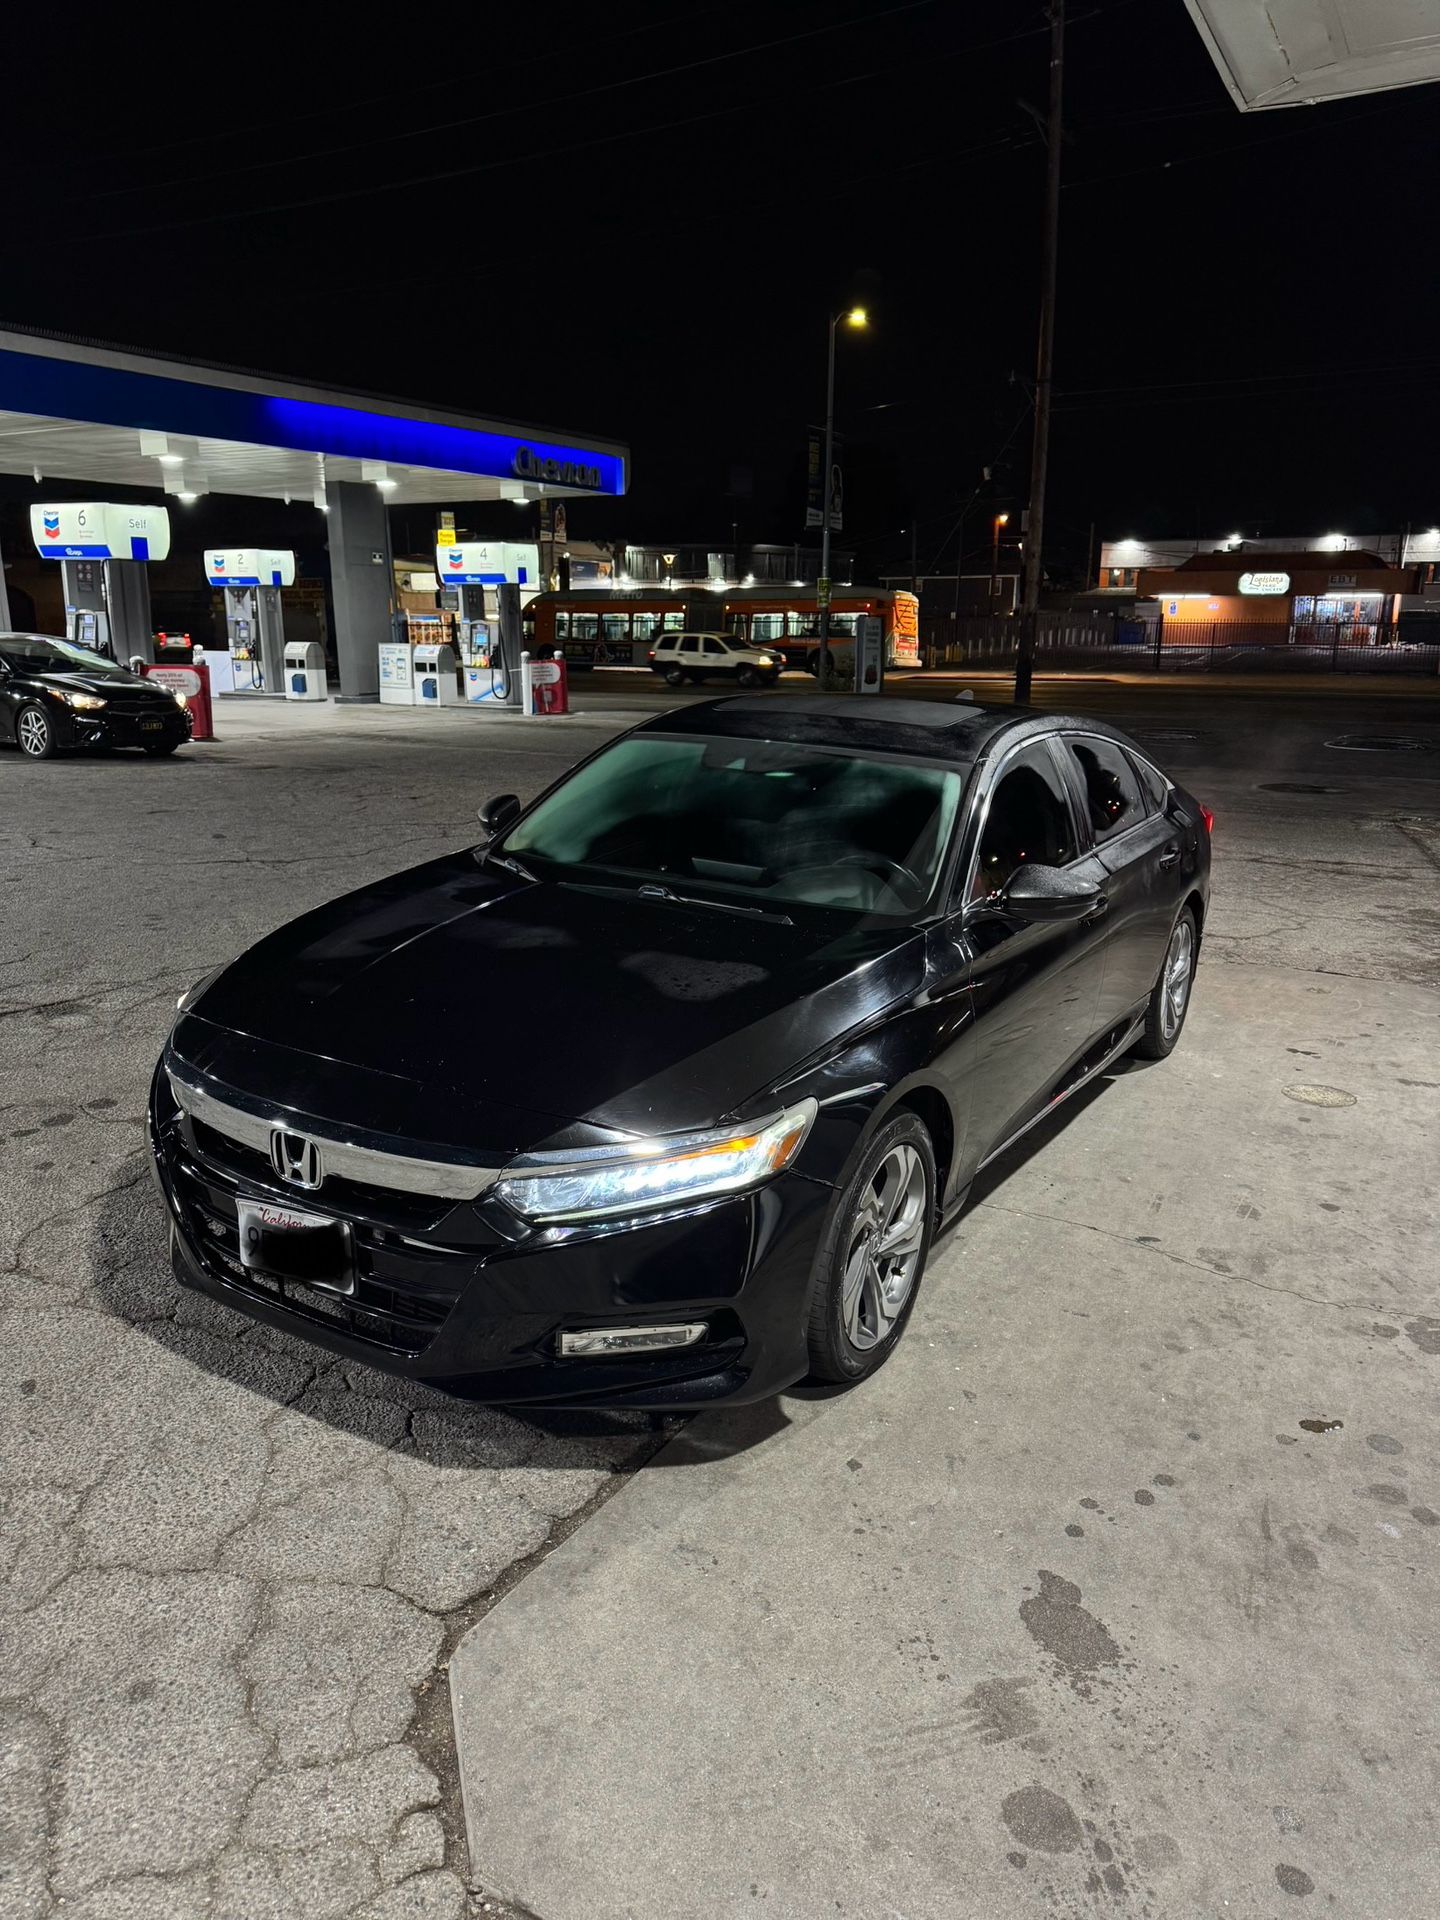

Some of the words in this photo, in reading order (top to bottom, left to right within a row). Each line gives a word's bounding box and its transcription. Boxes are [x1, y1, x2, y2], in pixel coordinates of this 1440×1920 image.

[512, 446, 601, 488] Chevron
[77, 509, 87, 526] 6
[128, 518, 147, 529] Self
[237, 553, 244, 565] 2
[479, 547, 488, 560] 4
[1331, 575, 1355, 583] EBT
[609, 591, 643, 600] Metro
